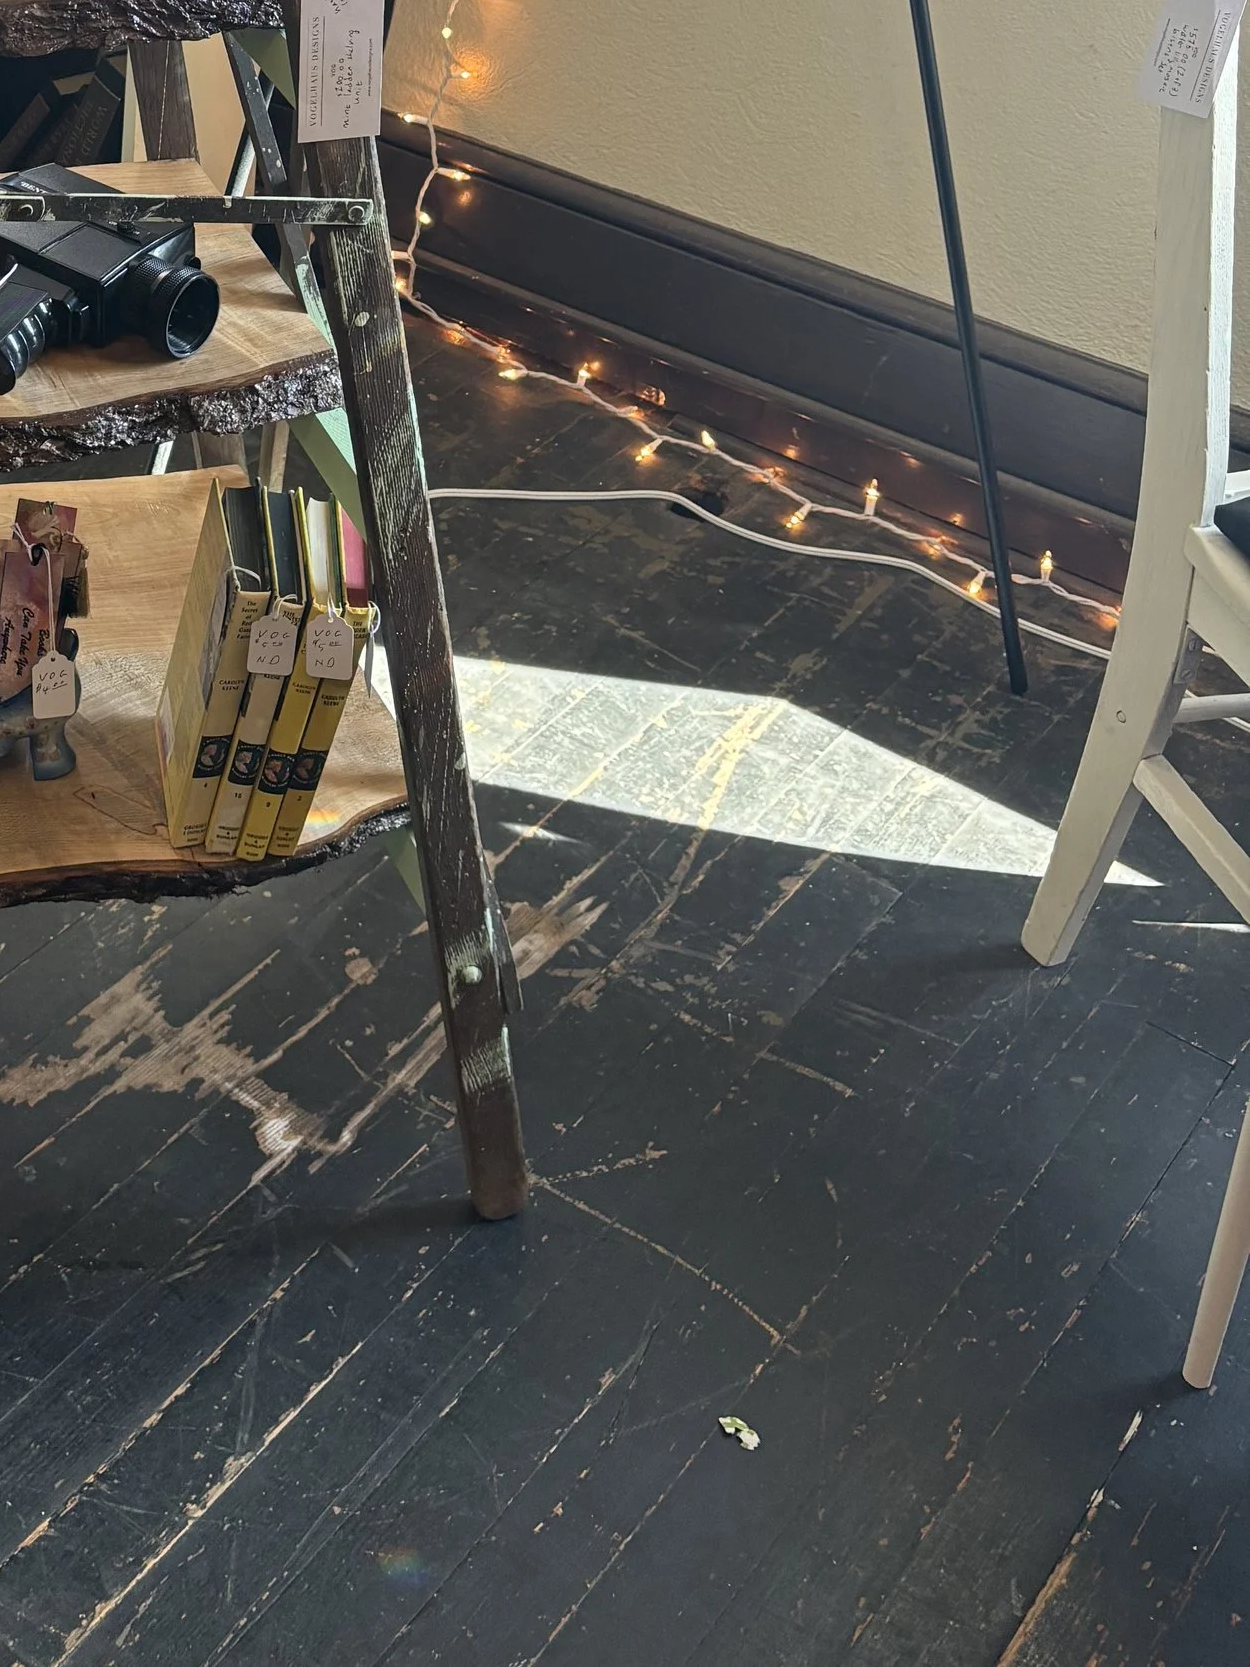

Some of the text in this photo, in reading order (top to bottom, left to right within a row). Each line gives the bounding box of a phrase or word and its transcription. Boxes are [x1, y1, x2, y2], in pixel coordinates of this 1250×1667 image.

[346, 29, 359, 59] shelving
[1195, 12, 1231, 104] VOGELHAUS DESIGNS
[309, 15, 320, 126] VOGELHAUS DESIGNS
[344, 66, 353, 96] ladder
[0, 616, 15, 665] Anywhere
[14, 607, 35, 676] Can Take You
[36, 628, 50, 656] Books
